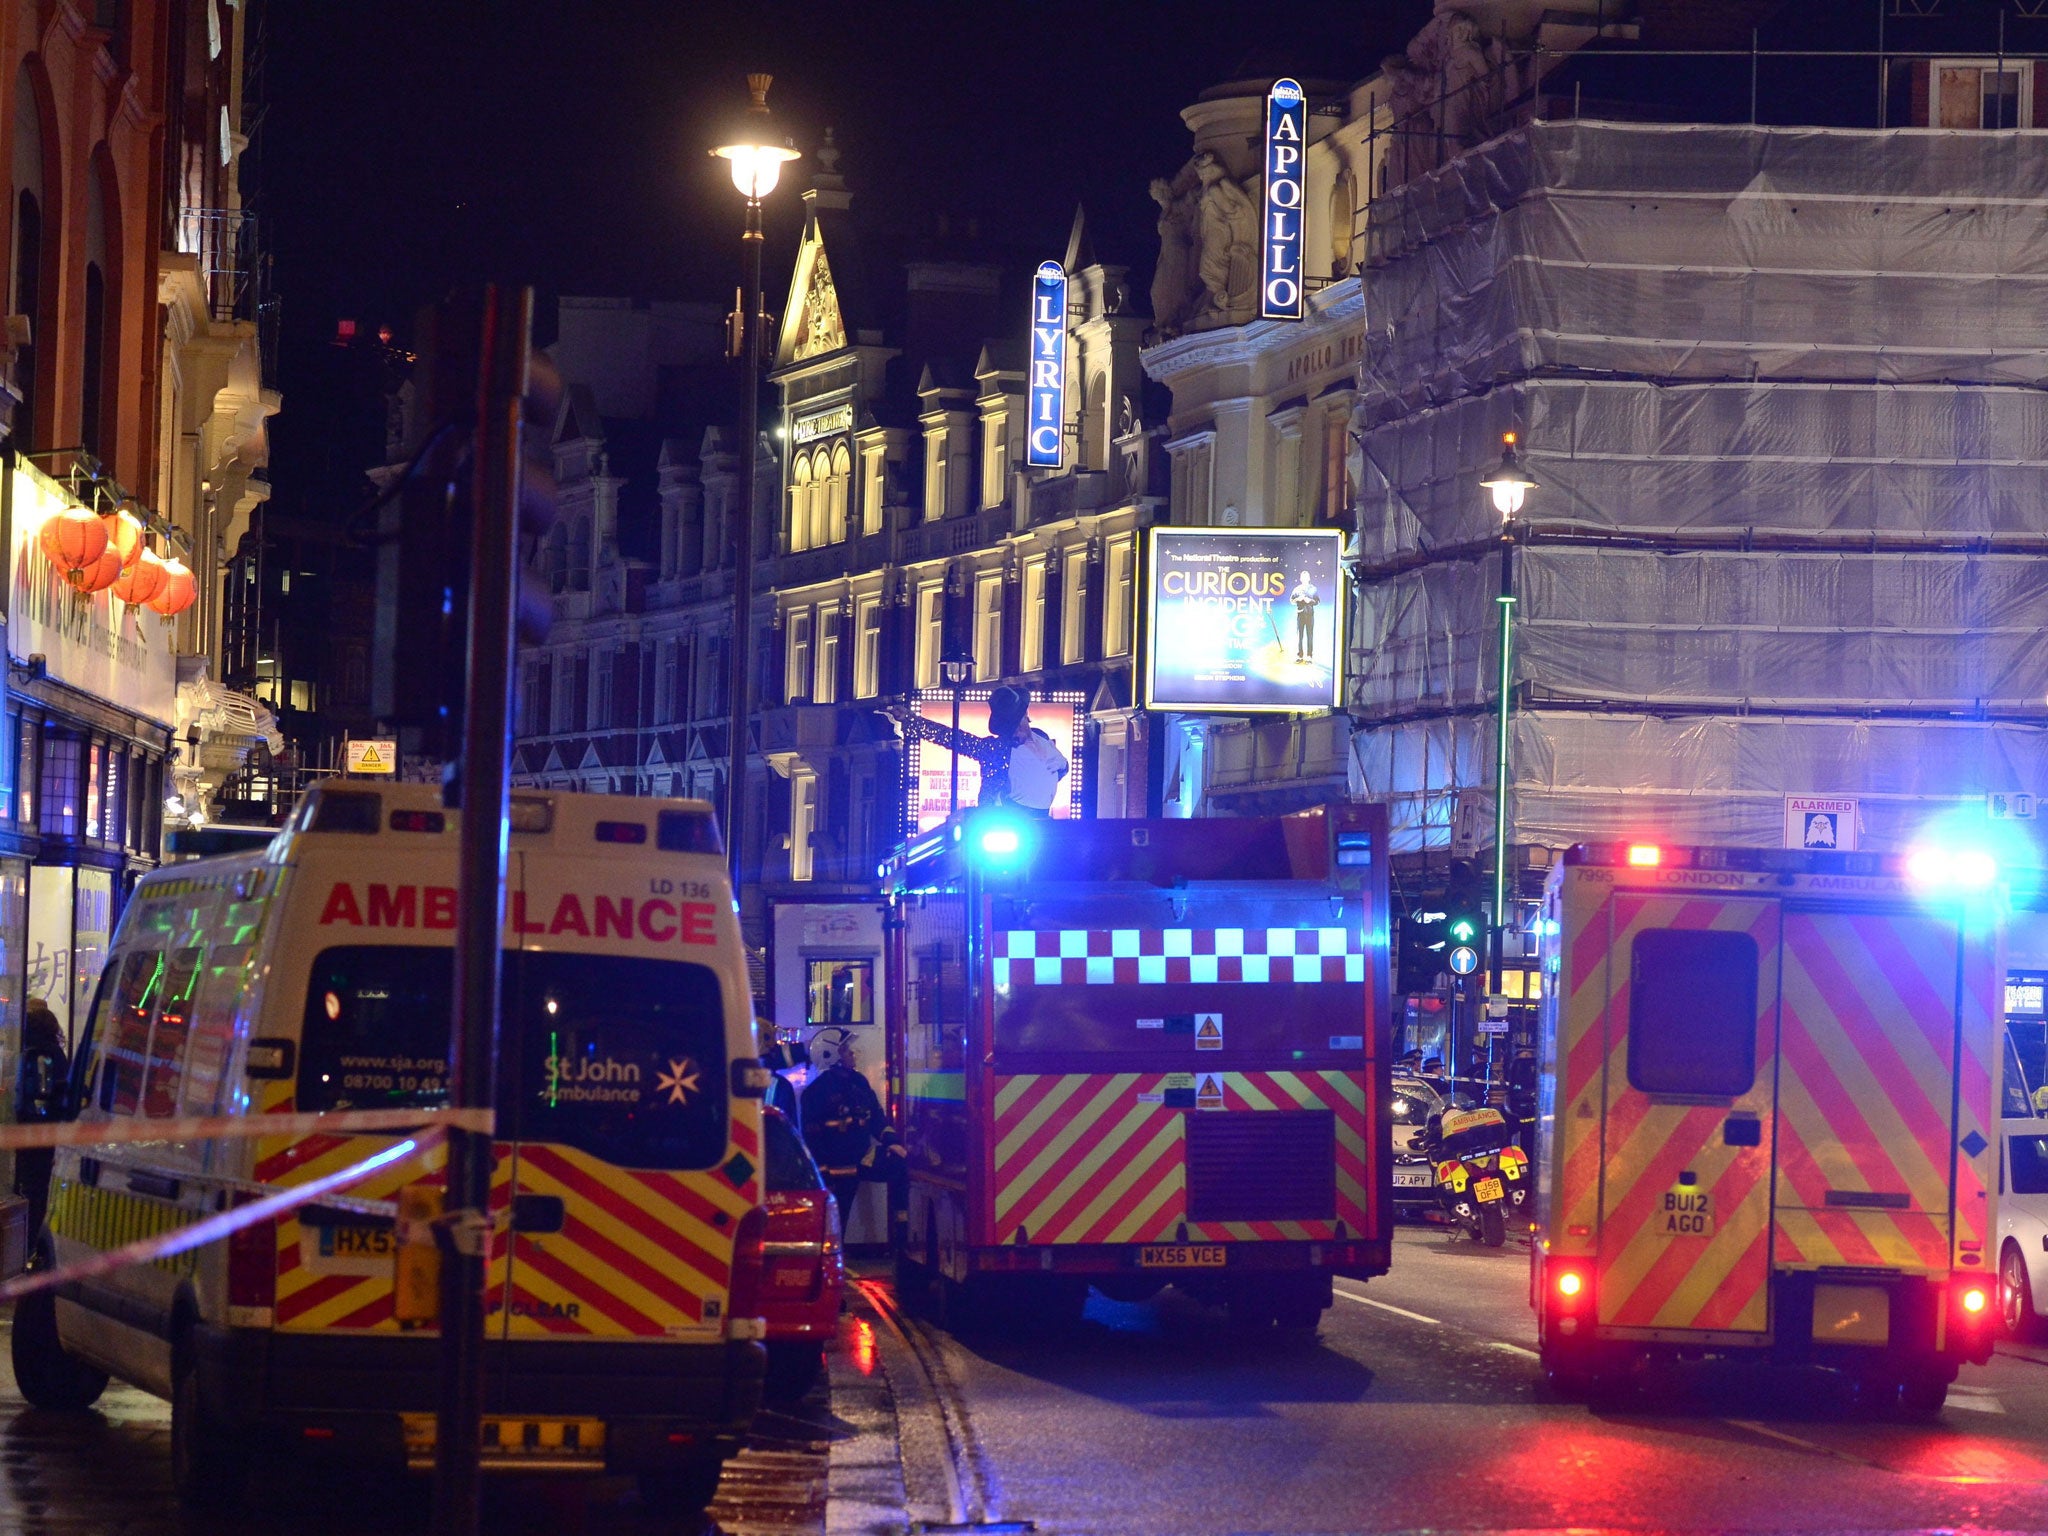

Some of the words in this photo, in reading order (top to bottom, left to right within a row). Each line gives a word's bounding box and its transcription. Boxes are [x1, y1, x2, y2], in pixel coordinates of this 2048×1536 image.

[1267, 113, 1300, 307] APOLLO
[1288, 345, 1331, 382] APOLLO
[1031, 296, 1063, 454] LYRIC
[798, 420, 818, 439] LYRIC
[818, 408, 848, 435] THEATRE
[1183, 554, 1211, 562] National
[1211, 554, 1239, 562] Theatre
[1163, 571, 1285, 596] CURIOUS
[1183, 596, 1274, 615] INCIDENT
[930, 778, 970, 790] MICEL
[921, 798, 966, 812] JACKSN
[1792, 801, 1851, 811] ALARMED
[1576, 868, 1615, 882] 7995
[1655, 870, 1745, 886] LONDON
[651, 878, 673, 894] LD
[681, 881, 710, 898] 136
[319, 882, 717, 946] AMBLANCE
[544, 1056, 572, 1081] St
[577, 1056, 640, 1082] John
[343, 1074, 393, 1089] 08700
[399, 1076, 417, 1090] 10
[543, 1084, 641, 1102] Ambulance
[1453, 1110, 1497, 1127] AMBULANCE
[1409, 1176, 1426, 1186] APY
[1475, 1180, 1500, 1193] LJ58
[1665, 1192, 1708, 1212] BU12
[1667, 1214, 1705, 1233] AGO
[338, 1229, 398, 1252] HX5
[1191, 1247, 1224, 1263] VCE
